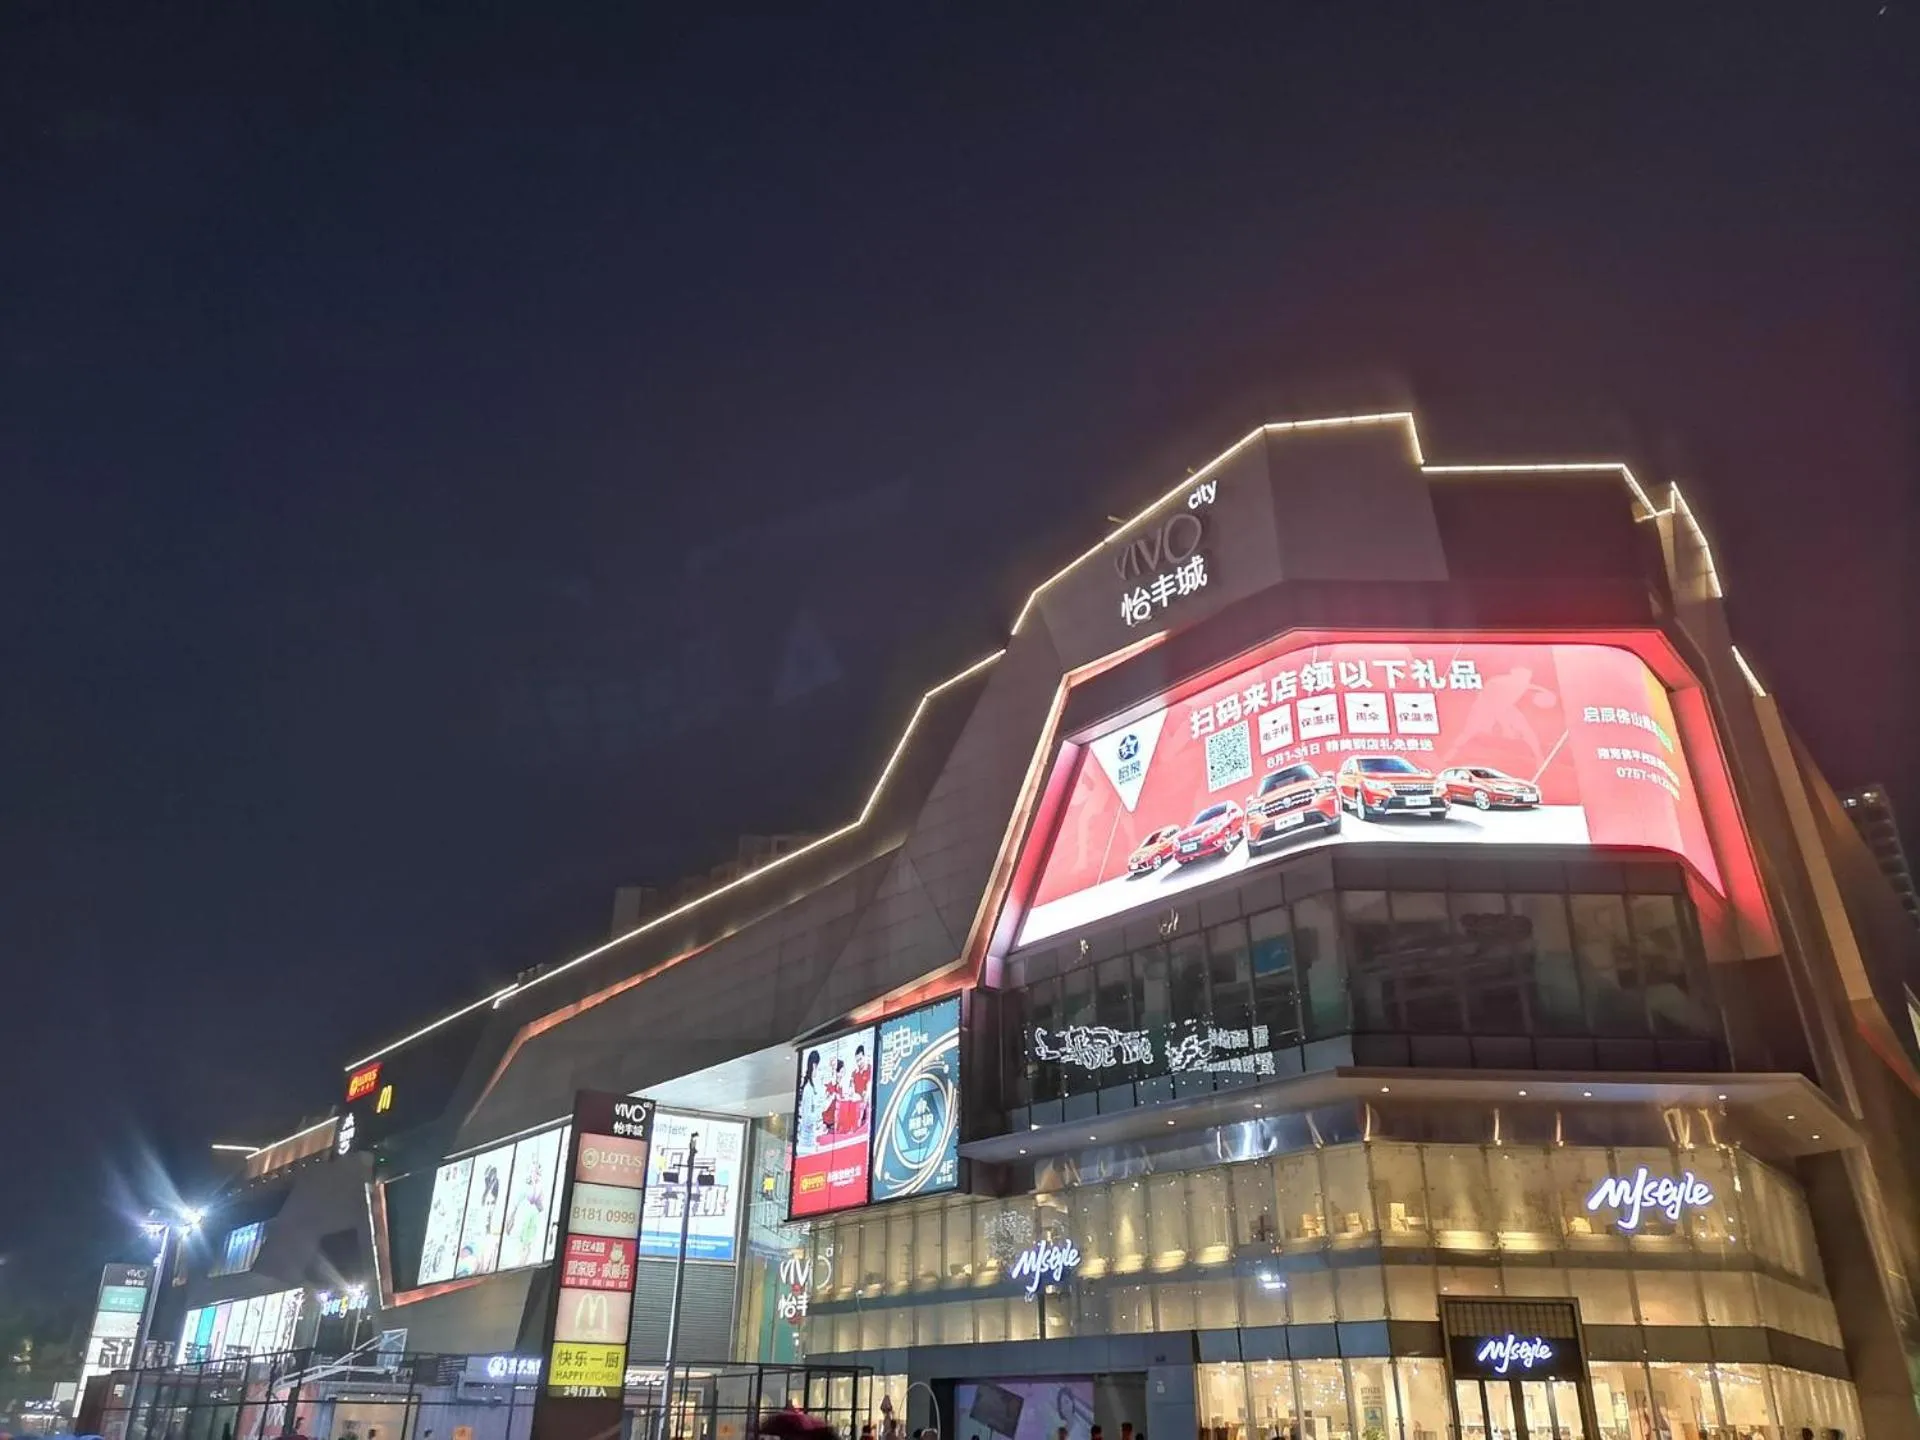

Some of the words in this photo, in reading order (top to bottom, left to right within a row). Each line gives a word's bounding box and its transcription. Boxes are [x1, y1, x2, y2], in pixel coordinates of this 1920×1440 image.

[1188, 480, 1217, 509] city
[1121, 554, 1207, 625] 怡丰城
[1190, 659, 1483, 738] 扫码来店领以下礼品
[615, 1103, 646, 1123] VIVO
[600, 1151, 643, 1168] LOTUS
[573, 1206, 603, 1221] 8181
[606, 1210, 636, 1225] 0999
[557, 1350, 620, 1369] 快乐一厨
[556, 1371, 584, 1381] HAPPY
